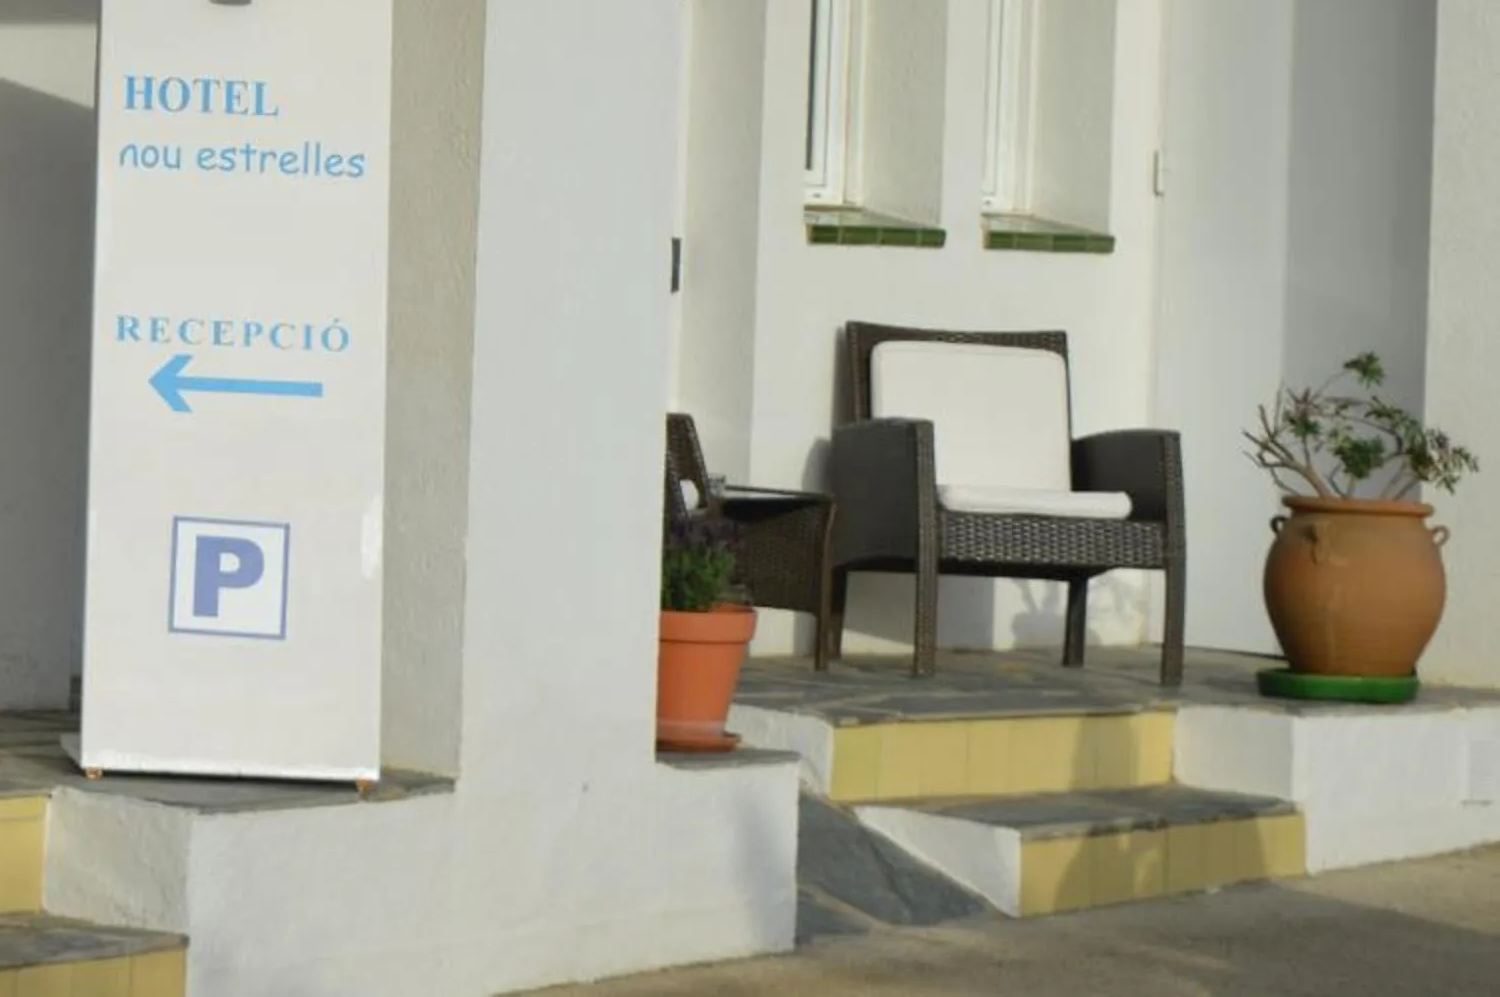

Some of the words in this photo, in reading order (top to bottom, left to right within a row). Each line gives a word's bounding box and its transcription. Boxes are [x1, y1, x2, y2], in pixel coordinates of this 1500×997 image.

[123, 73, 279, 117] HOTEL
[118, 143, 182, 170] nou
[195, 141, 366, 179] estrelles
[115, 314, 351, 353] RECEPCIÓ
[193, 534, 265, 618] P
